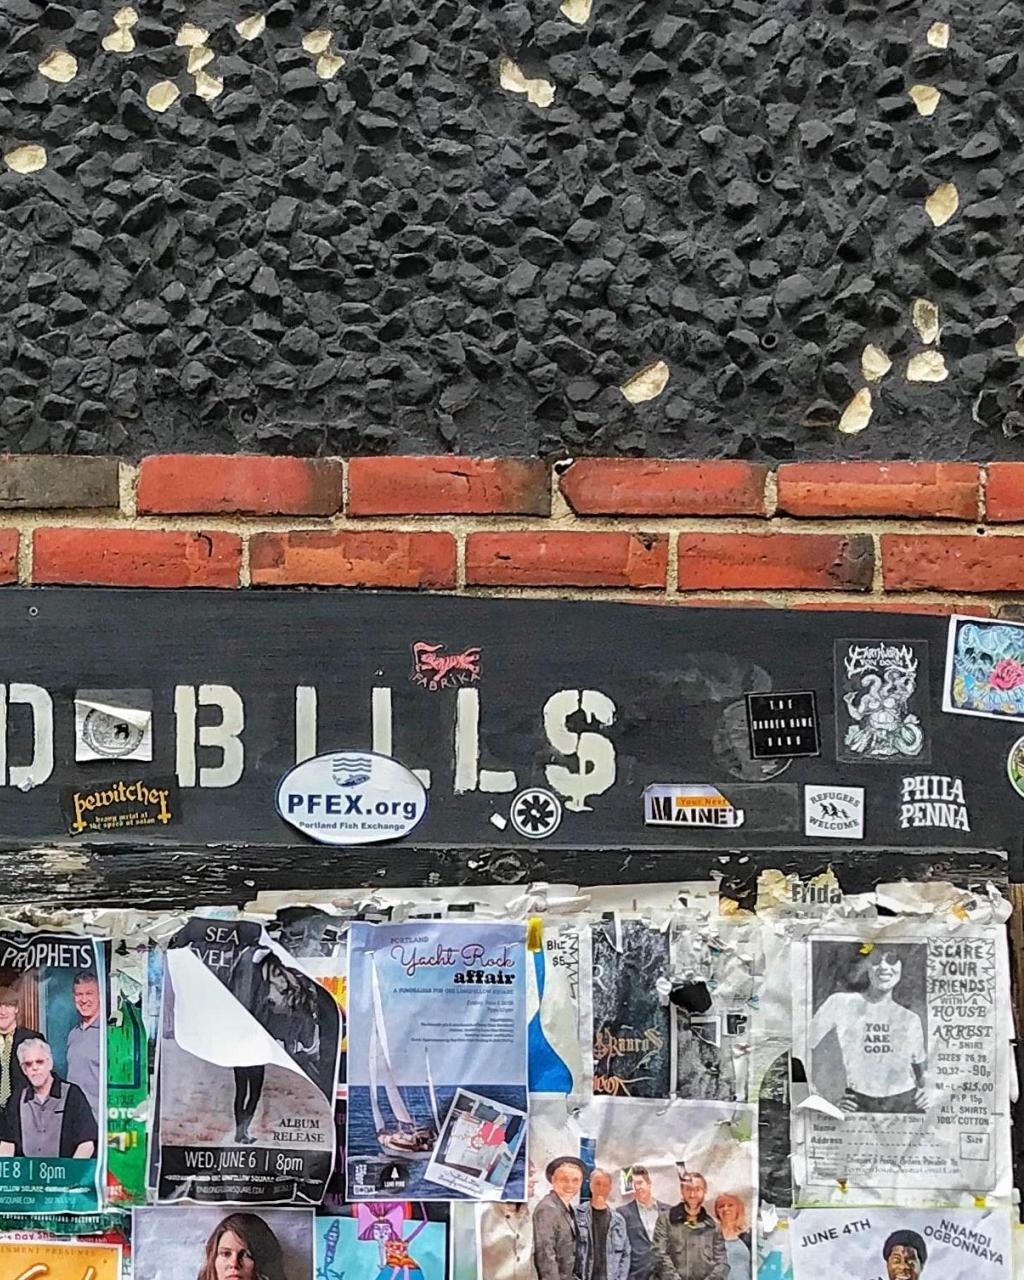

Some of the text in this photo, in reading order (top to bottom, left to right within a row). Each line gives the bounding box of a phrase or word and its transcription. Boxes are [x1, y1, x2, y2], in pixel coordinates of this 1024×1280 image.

[901, 775, 965, 804] PHILA
[287, 793, 417, 821] PFEX.org
[299, 821, 406, 831] Portland Fish Exchange
[899, 803, 971, 832] PENNA
[205, 926, 239, 943] SEA
[1, 944, 92, 971] PROPHETS
[932, 943, 984, 959] SCARE
[453, 969, 516, 986] affair
[938, 961, 978, 977] YOUR
[931, 978, 986, 995] FRIENDS
[865, 1023, 890, 1033] YOU
[864, 1034, 890, 1044] ARE
[279, 1117, 320, 1129] ALBUM
[273, 1130, 325, 1144] RELEASE
[13, 1161, 21, 1177] 8
[39, 1162, 66, 1183] 8pm
[800, 1219, 872, 1248] JUNE 4TH
[939, 1219, 992, 1249] NNAMDI
[924, 1226, 1004, 1265] OGBONNAYA
